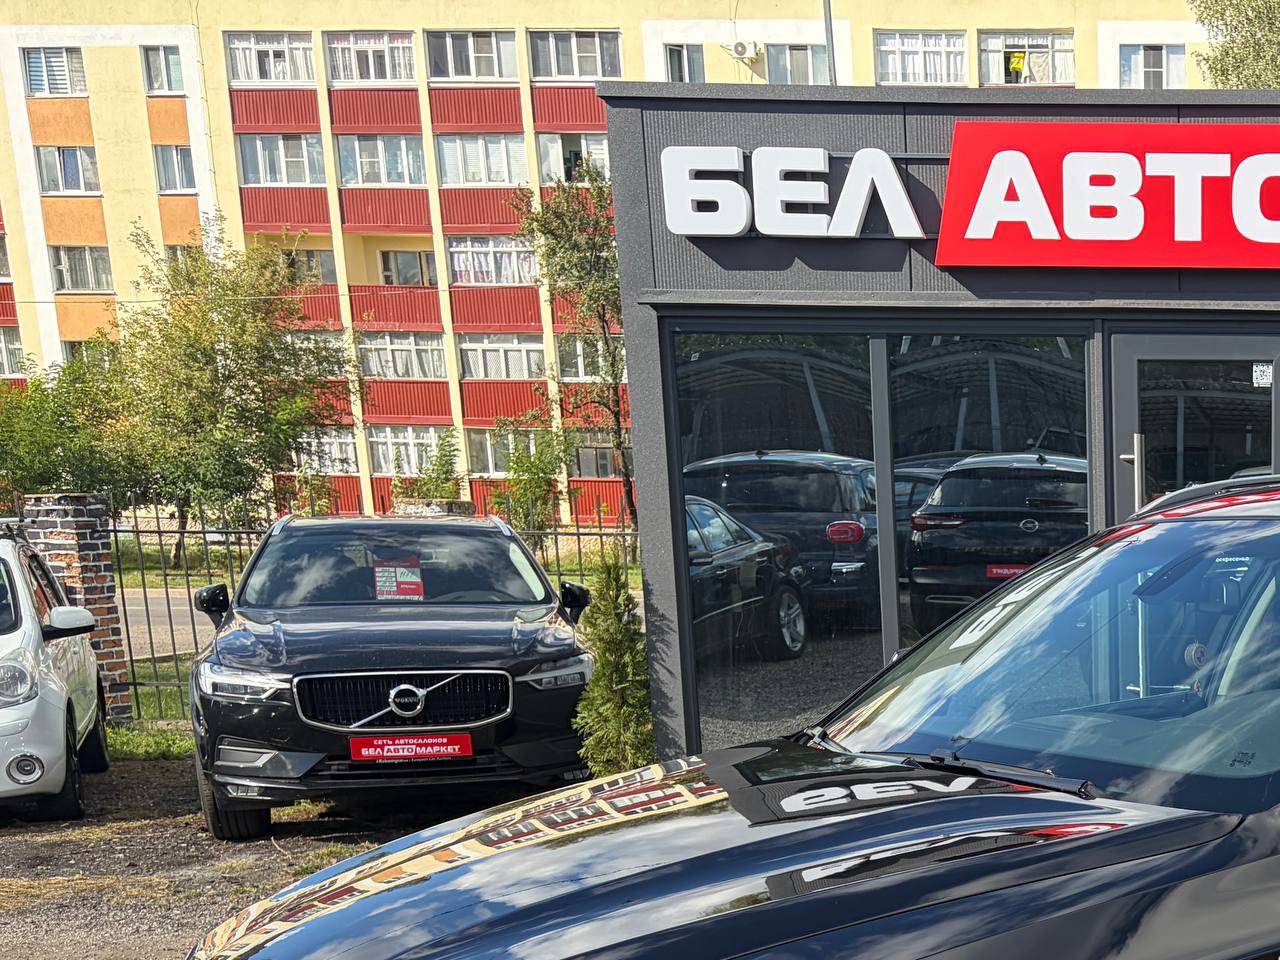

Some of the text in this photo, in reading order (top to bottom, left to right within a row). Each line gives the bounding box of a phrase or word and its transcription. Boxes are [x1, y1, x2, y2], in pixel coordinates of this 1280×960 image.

[661, 145, 926, 239] БЕЛ
[394, 737, 448, 745] АВТОСАЛОНОВ
[361, 745, 461, 756] БЕЛ АВТО МАРКЕТ
